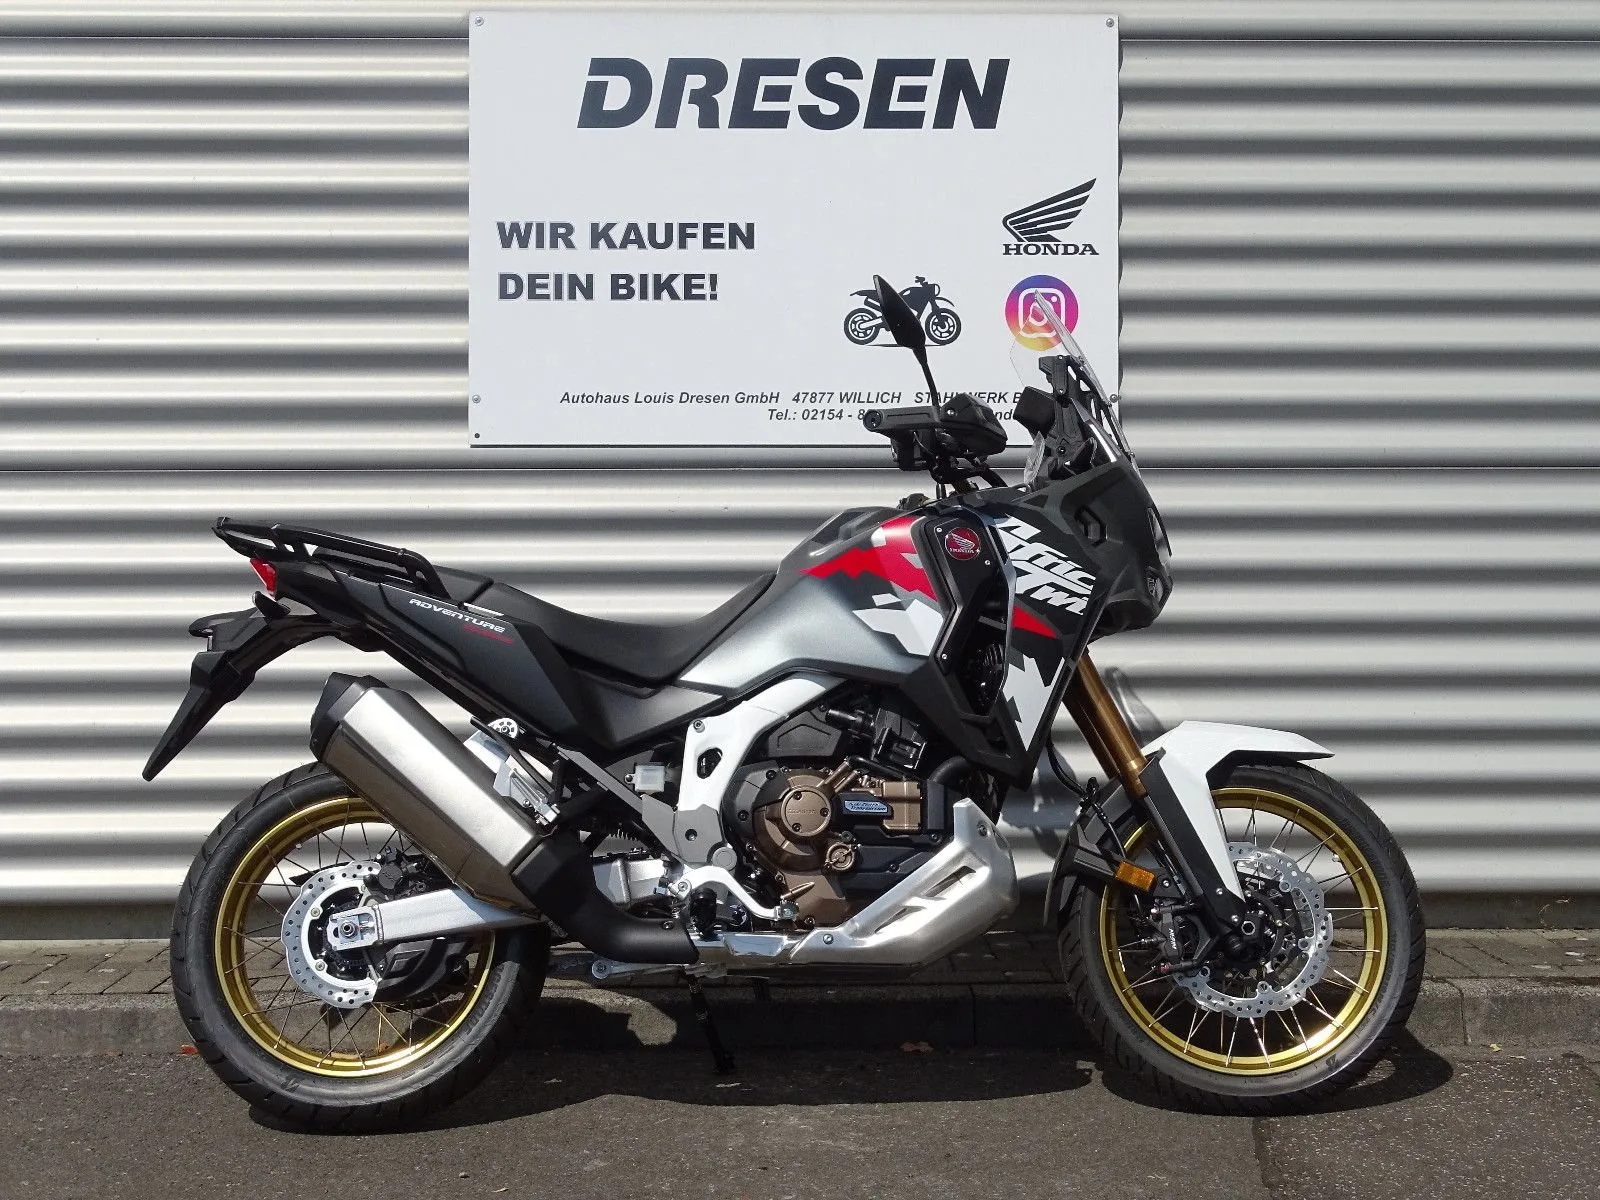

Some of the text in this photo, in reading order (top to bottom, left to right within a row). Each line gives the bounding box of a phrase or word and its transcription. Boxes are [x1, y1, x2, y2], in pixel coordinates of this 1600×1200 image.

[577, 56, 1011, 131] DRESEN
[497, 221, 756, 250] WIR KAUFEN
[1002, 243, 1099, 256] HONDA
[498, 272, 719, 301] DEIN BIKE!
[560, 391, 630, 404] Autohaus
[634, 391, 674, 404] Louis
[679, 391, 730, 404] Dresen
[735, 391, 780, 404] GmbH
[791, 391, 835, 404] 47877
[839, 391, 902, 404] WILLICH
[914, 391, 1008, 404] STAHERK
[767, 408, 797, 421] Tel.:
[802, 408, 843, 421] 02154
